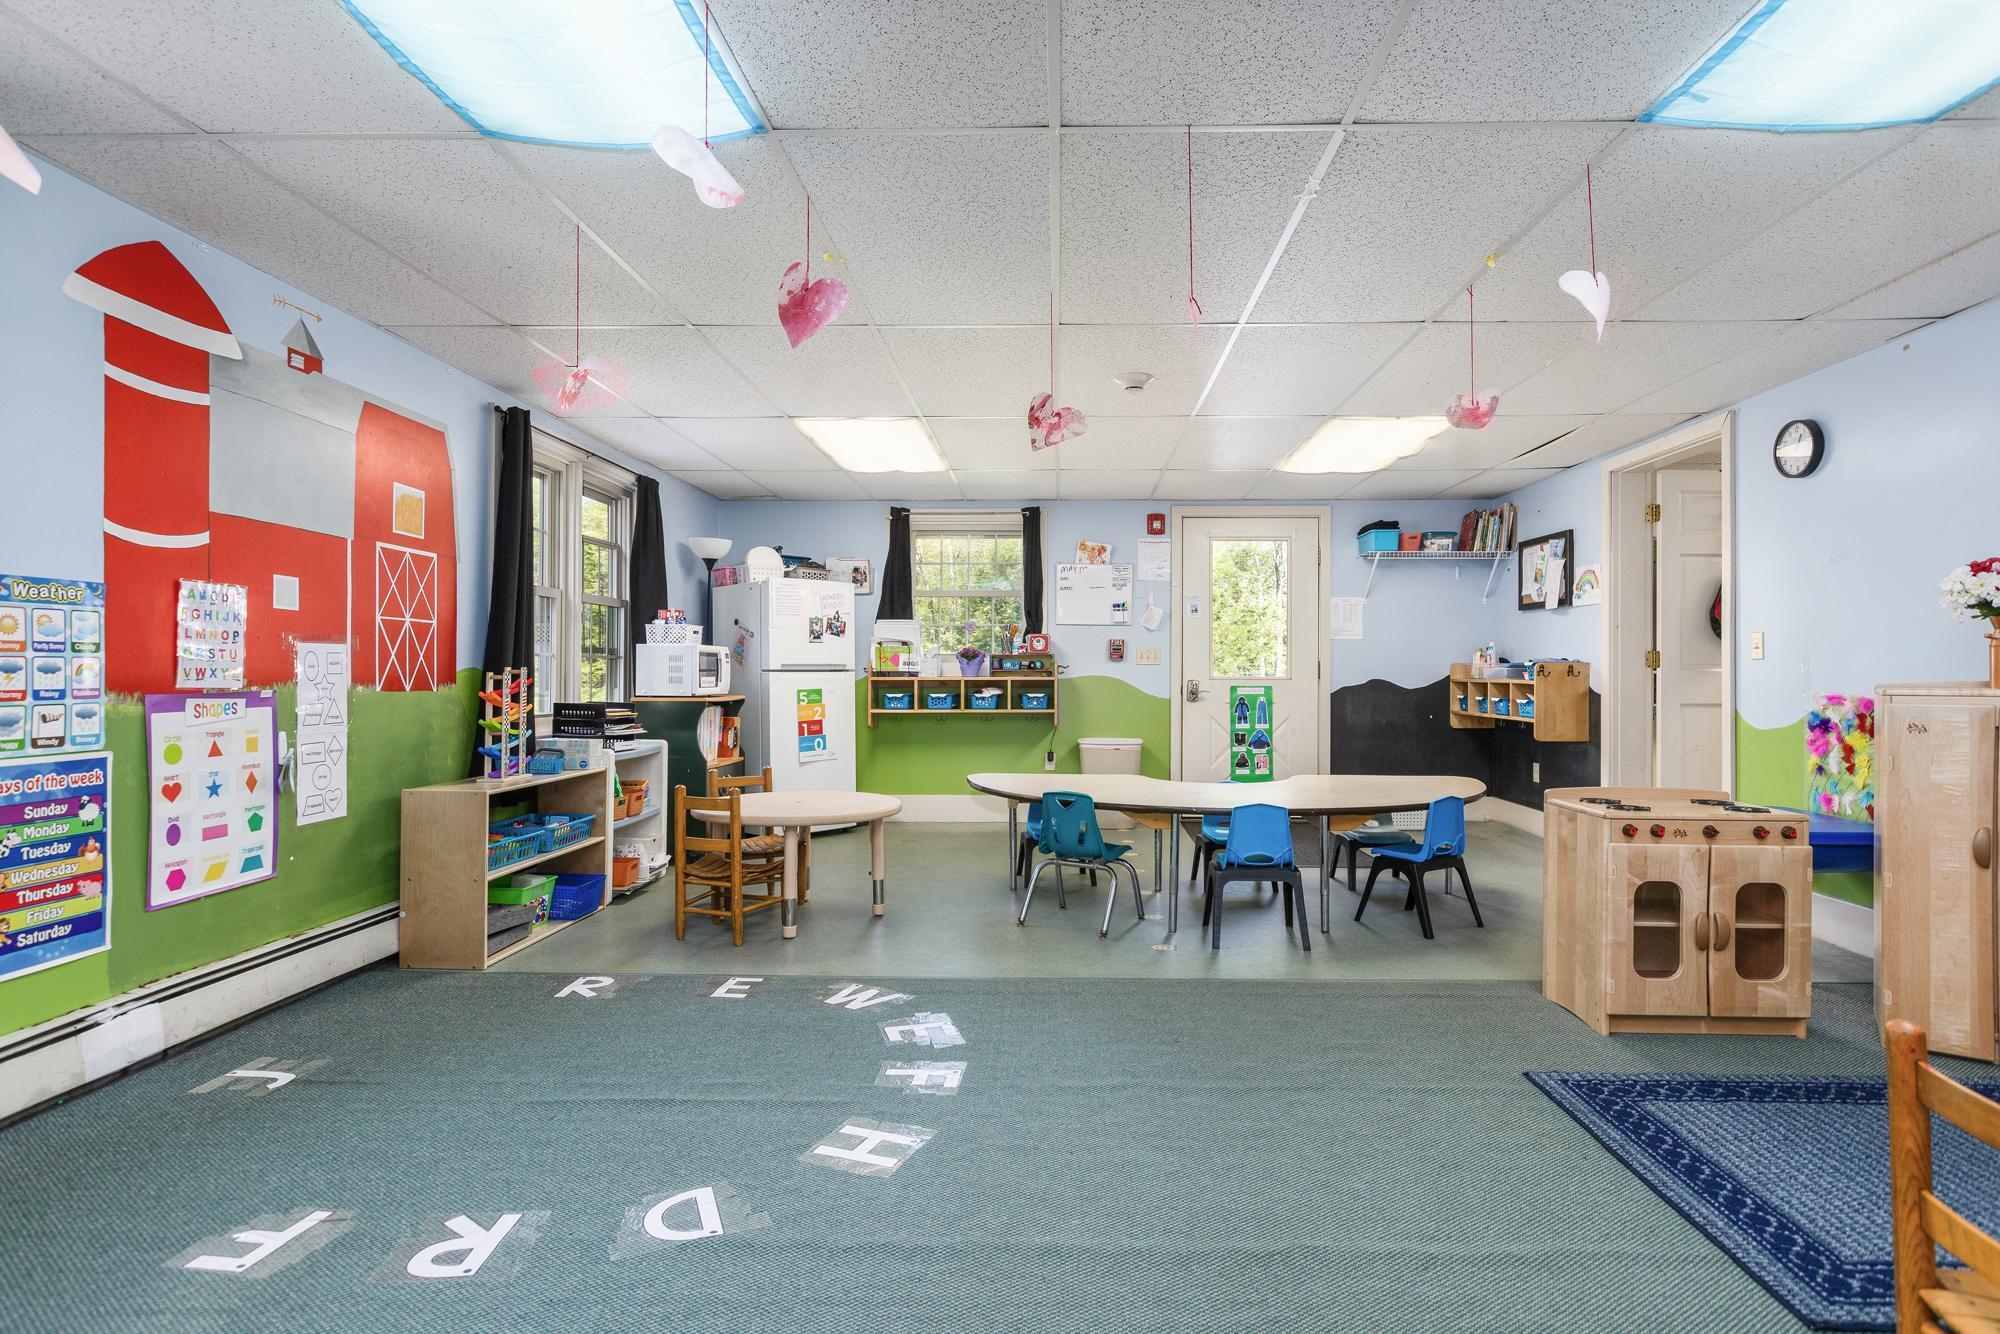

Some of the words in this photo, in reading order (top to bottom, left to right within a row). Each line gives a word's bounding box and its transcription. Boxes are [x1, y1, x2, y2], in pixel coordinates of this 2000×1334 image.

[12, 580, 84, 601] Weather
[187, 588, 196, 600] A
[199, 590, 207, 600] B
[211, 591, 219, 601] C
[222, 592, 229, 603] D
[191, 608, 201, 620] G
[204, 609, 212, 620] H
[215, 610, 219, 620] I
[222, 611, 230, 621] J
[233, 612, 241, 623] K
[185, 627, 192, 639] L
[195, 629, 206, 640] M
[209, 630, 218, 640] N
[221, 630, 229, 640] O
[232, 630, 240, 641] P
[208, 648, 216, 659] S
[219, 648, 226, 659] T
[230, 649, 238, 660] U
[183, 667, 191, 678] V
[195, 667, 207, 679] W
[209, 667, 218, 679] X
[221, 667, 229, 679] Y
[799, 691, 808, 705] 5
[193, 702, 238, 719] Shapes
[814, 706, 822, 720] 2
[802, 723, 808, 737] 1
[0, 741, 19, 749] oggy
[37, 738, 60, 746] Windy
[815, 738, 823, 751] 0
[0, 781, 21, 794] ays
[26, 776, 41, 791] of
[45, 774, 66, 789] the
[70, 770, 102, 786] week
[24, 803, 69, 819] Sunday
[23, 823, 70, 840] Monday
[20, 842, 71, 860] Tuesday
[10, 862, 78, 884] Wednesday
[16, 883, 74, 904] Thursday
[26, 906, 64, 924] Friday
[16, 924, 72, 947] Saturday
[554, 976, 615, 998] R
[710, 977, 764, 999] E
[824, 983, 905, 1010] W
[885, 1069, 960, 1088] F
[812, 1125, 921, 1168] H
[643, 1186, 725, 1241] D
[184, 1210, 332, 1272] F
[406, 1213, 523, 1278] R
